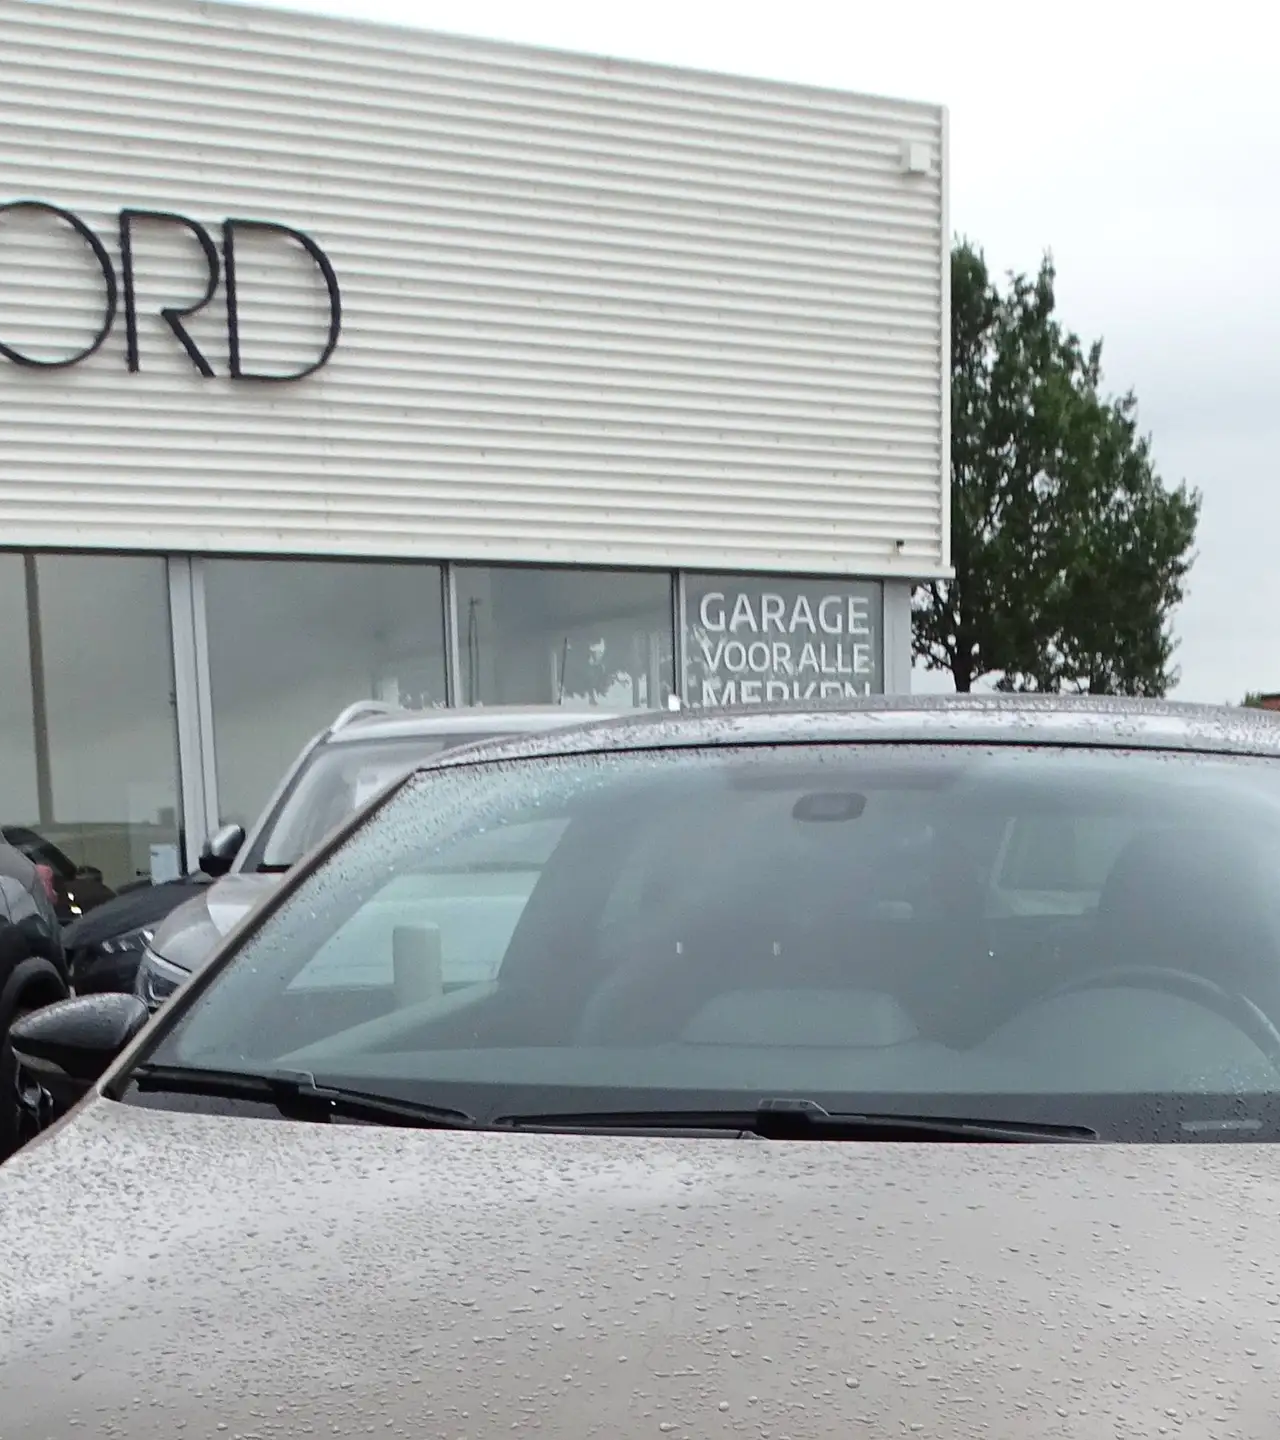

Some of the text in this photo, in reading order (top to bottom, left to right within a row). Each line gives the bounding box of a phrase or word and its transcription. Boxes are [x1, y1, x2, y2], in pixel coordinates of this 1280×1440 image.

[699, 592, 870, 634] GARAGE
[700, 640, 871, 675] VOOR ALLE
